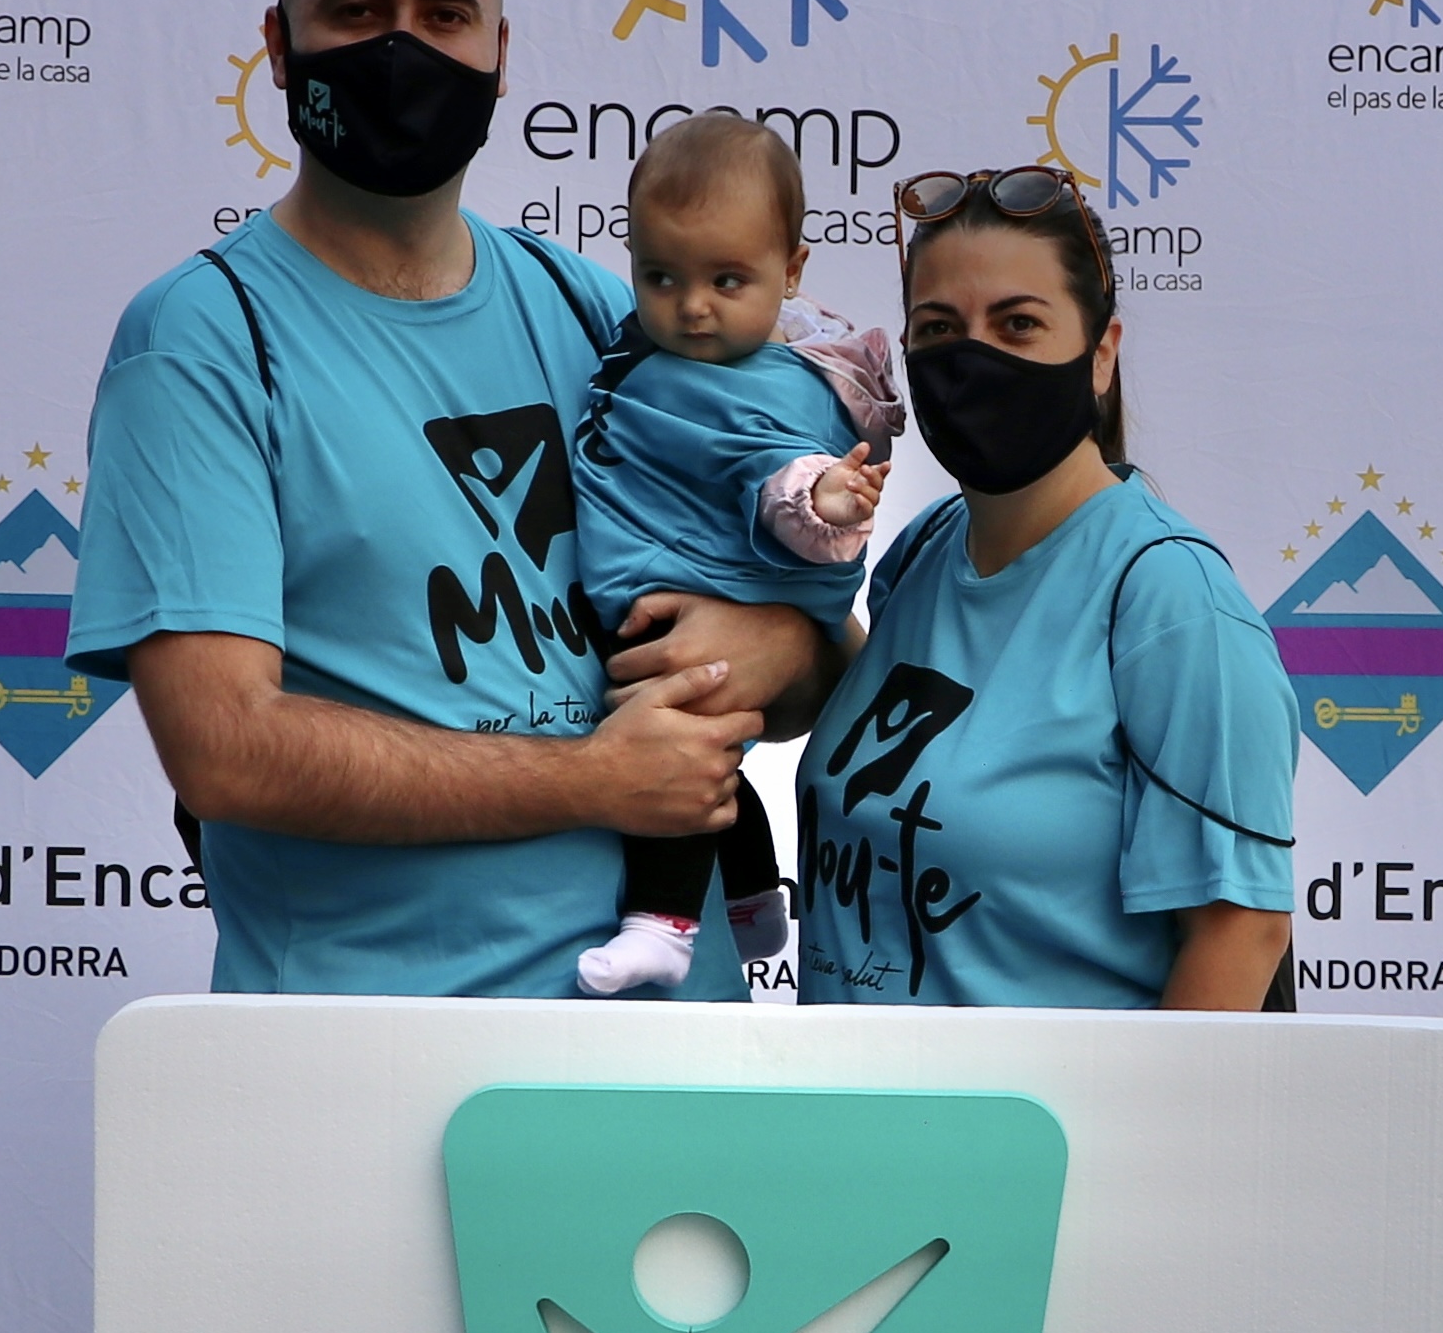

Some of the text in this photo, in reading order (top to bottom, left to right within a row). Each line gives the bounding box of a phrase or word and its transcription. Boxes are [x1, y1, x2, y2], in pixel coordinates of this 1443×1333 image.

[17, 56, 35, 81] la
[39, 64, 90, 83] casa
[1327, 83, 1347, 108] el
[1353, 91, 1392, 116] pas
[1396, 85, 1427, 110] de
[521, 185, 560, 236] el
[577, 203, 630, 254] pa
[1109, 226, 1202, 268] amp
[1131, 267, 1148, 291] la
[1153, 274, 1202, 291] casa
[528, 690, 556, 729] la
